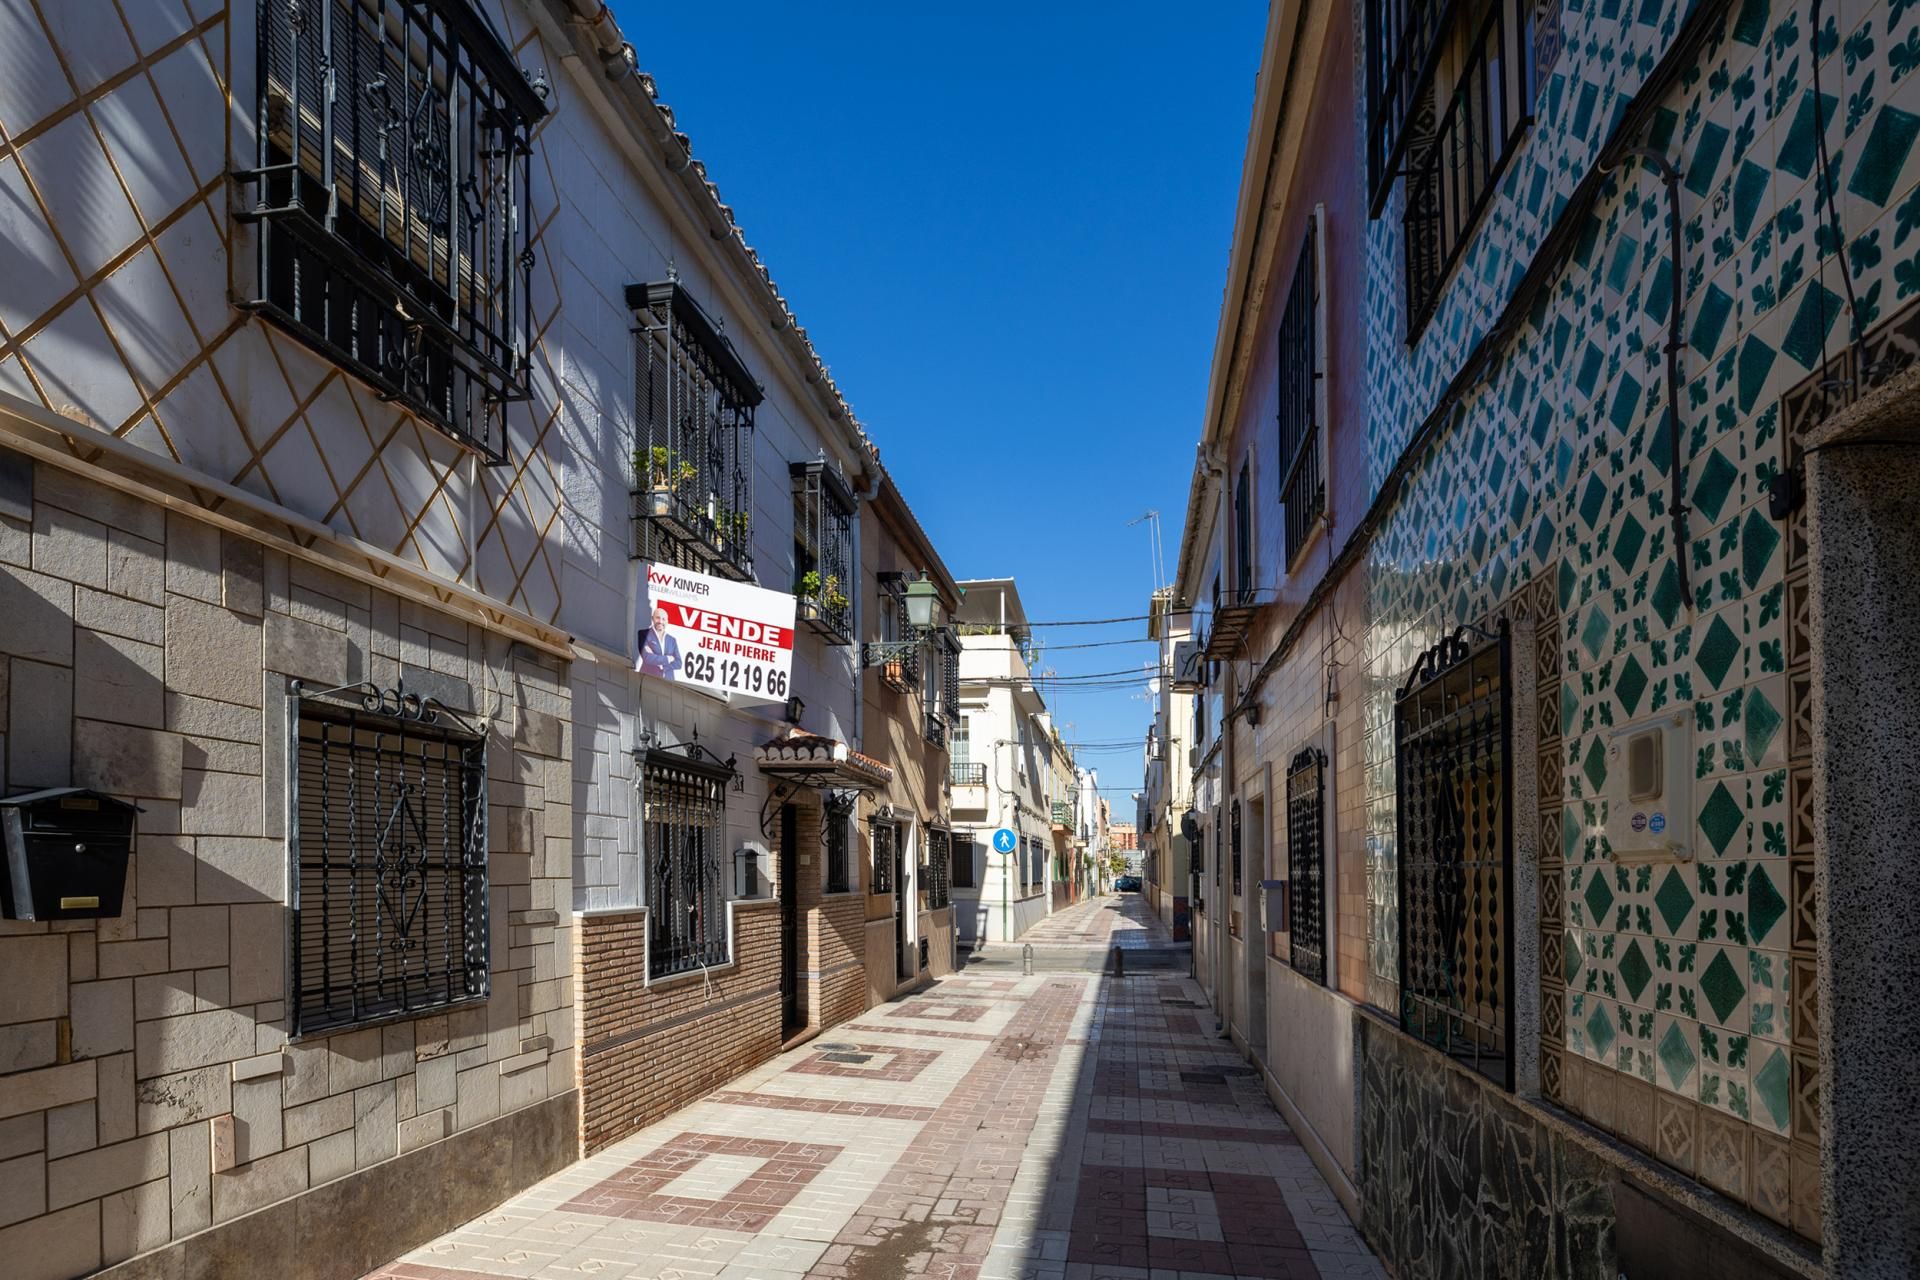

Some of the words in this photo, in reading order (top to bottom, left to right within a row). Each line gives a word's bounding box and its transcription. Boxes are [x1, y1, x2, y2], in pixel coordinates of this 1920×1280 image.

[673, 577, 710, 597] KINVER
[678, 606, 780, 647] VENDE
[698, 636, 730, 654] JEAN
[734, 643, 776, 663] PIERRE
[684, 651, 715, 683] 625
[720, 659, 739, 688] 12
[744, 664, 762, 692] 19
[767, 668, 787, 697] 66
